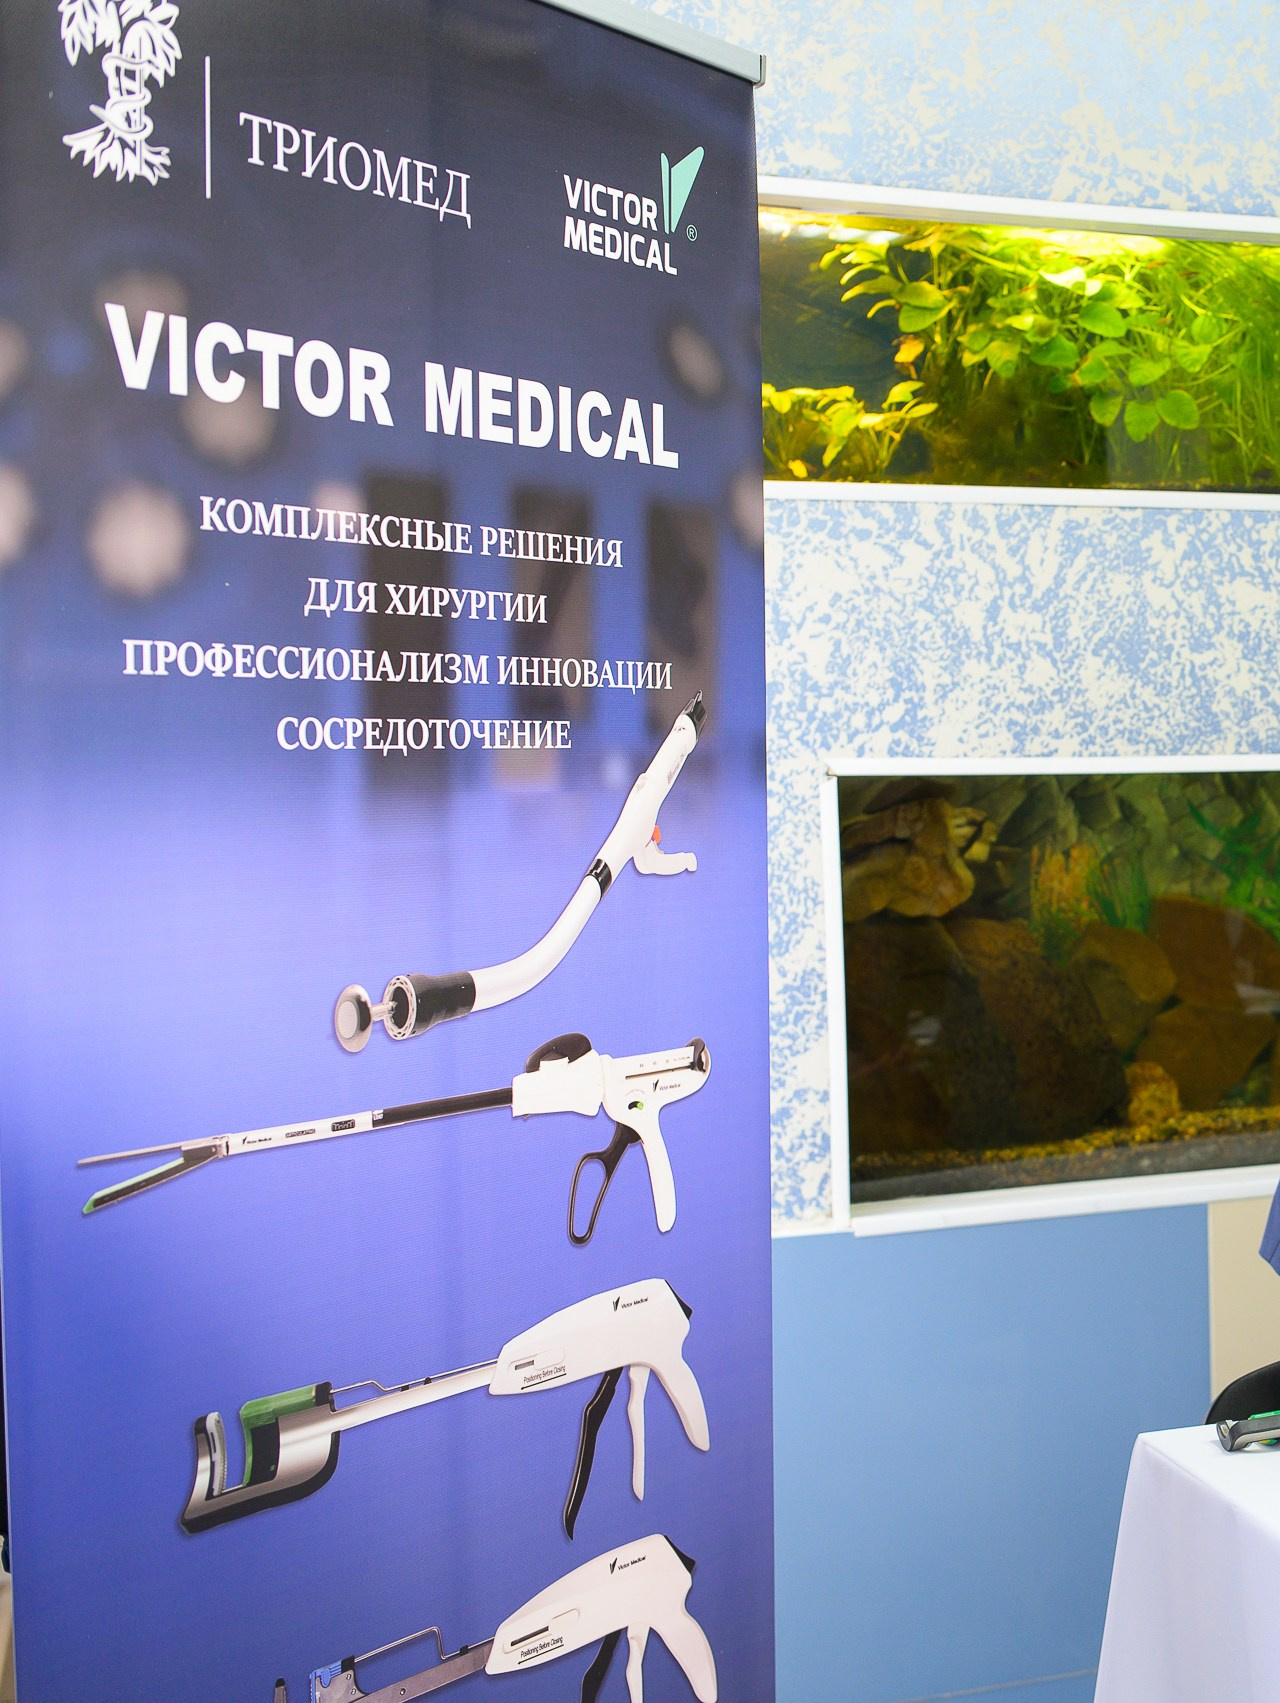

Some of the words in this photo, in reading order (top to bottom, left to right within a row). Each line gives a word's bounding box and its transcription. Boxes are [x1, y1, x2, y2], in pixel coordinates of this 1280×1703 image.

[238, 110, 473, 229] ТРИОМЕД
[563, 173, 658, 233] VICTOR
[563, 215, 678, 276] MEDICAL
[104, 302, 395, 427] VICTOR
[423, 361, 680, 470] MEDICAL
[199, 495, 474, 554] КОМПЛЕКСНЫЕ
[480, 527, 624, 568] РЕШЕНИЯ
[303, 576, 376, 618] ДЛЯ
[385, 582, 548, 624] ХИРУРГИИ
[122, 638, 490, 686] ПРОФЕССИОНАЛИЗМ
[496, 655, 673, 695] ИННОВАЦИИ
[276, 715, 573, 757] СОСРЕДОТОЧЕНИЕ
[633, 1297, 649, 1306] Medical
[523, 1371, 542, 1384] Positioning
[542, 1369, 553, 1379] Before
[553, 1365, 566, 1376] Closing
[618, 1563, 629, 1571] Victor
[631, 1555, 646, 1566] Medical
[520, 1645, 539, 1659] Positioning
[539, 1641, 550, 1652] Before
[550, 1636, 563, 1648] Closing
